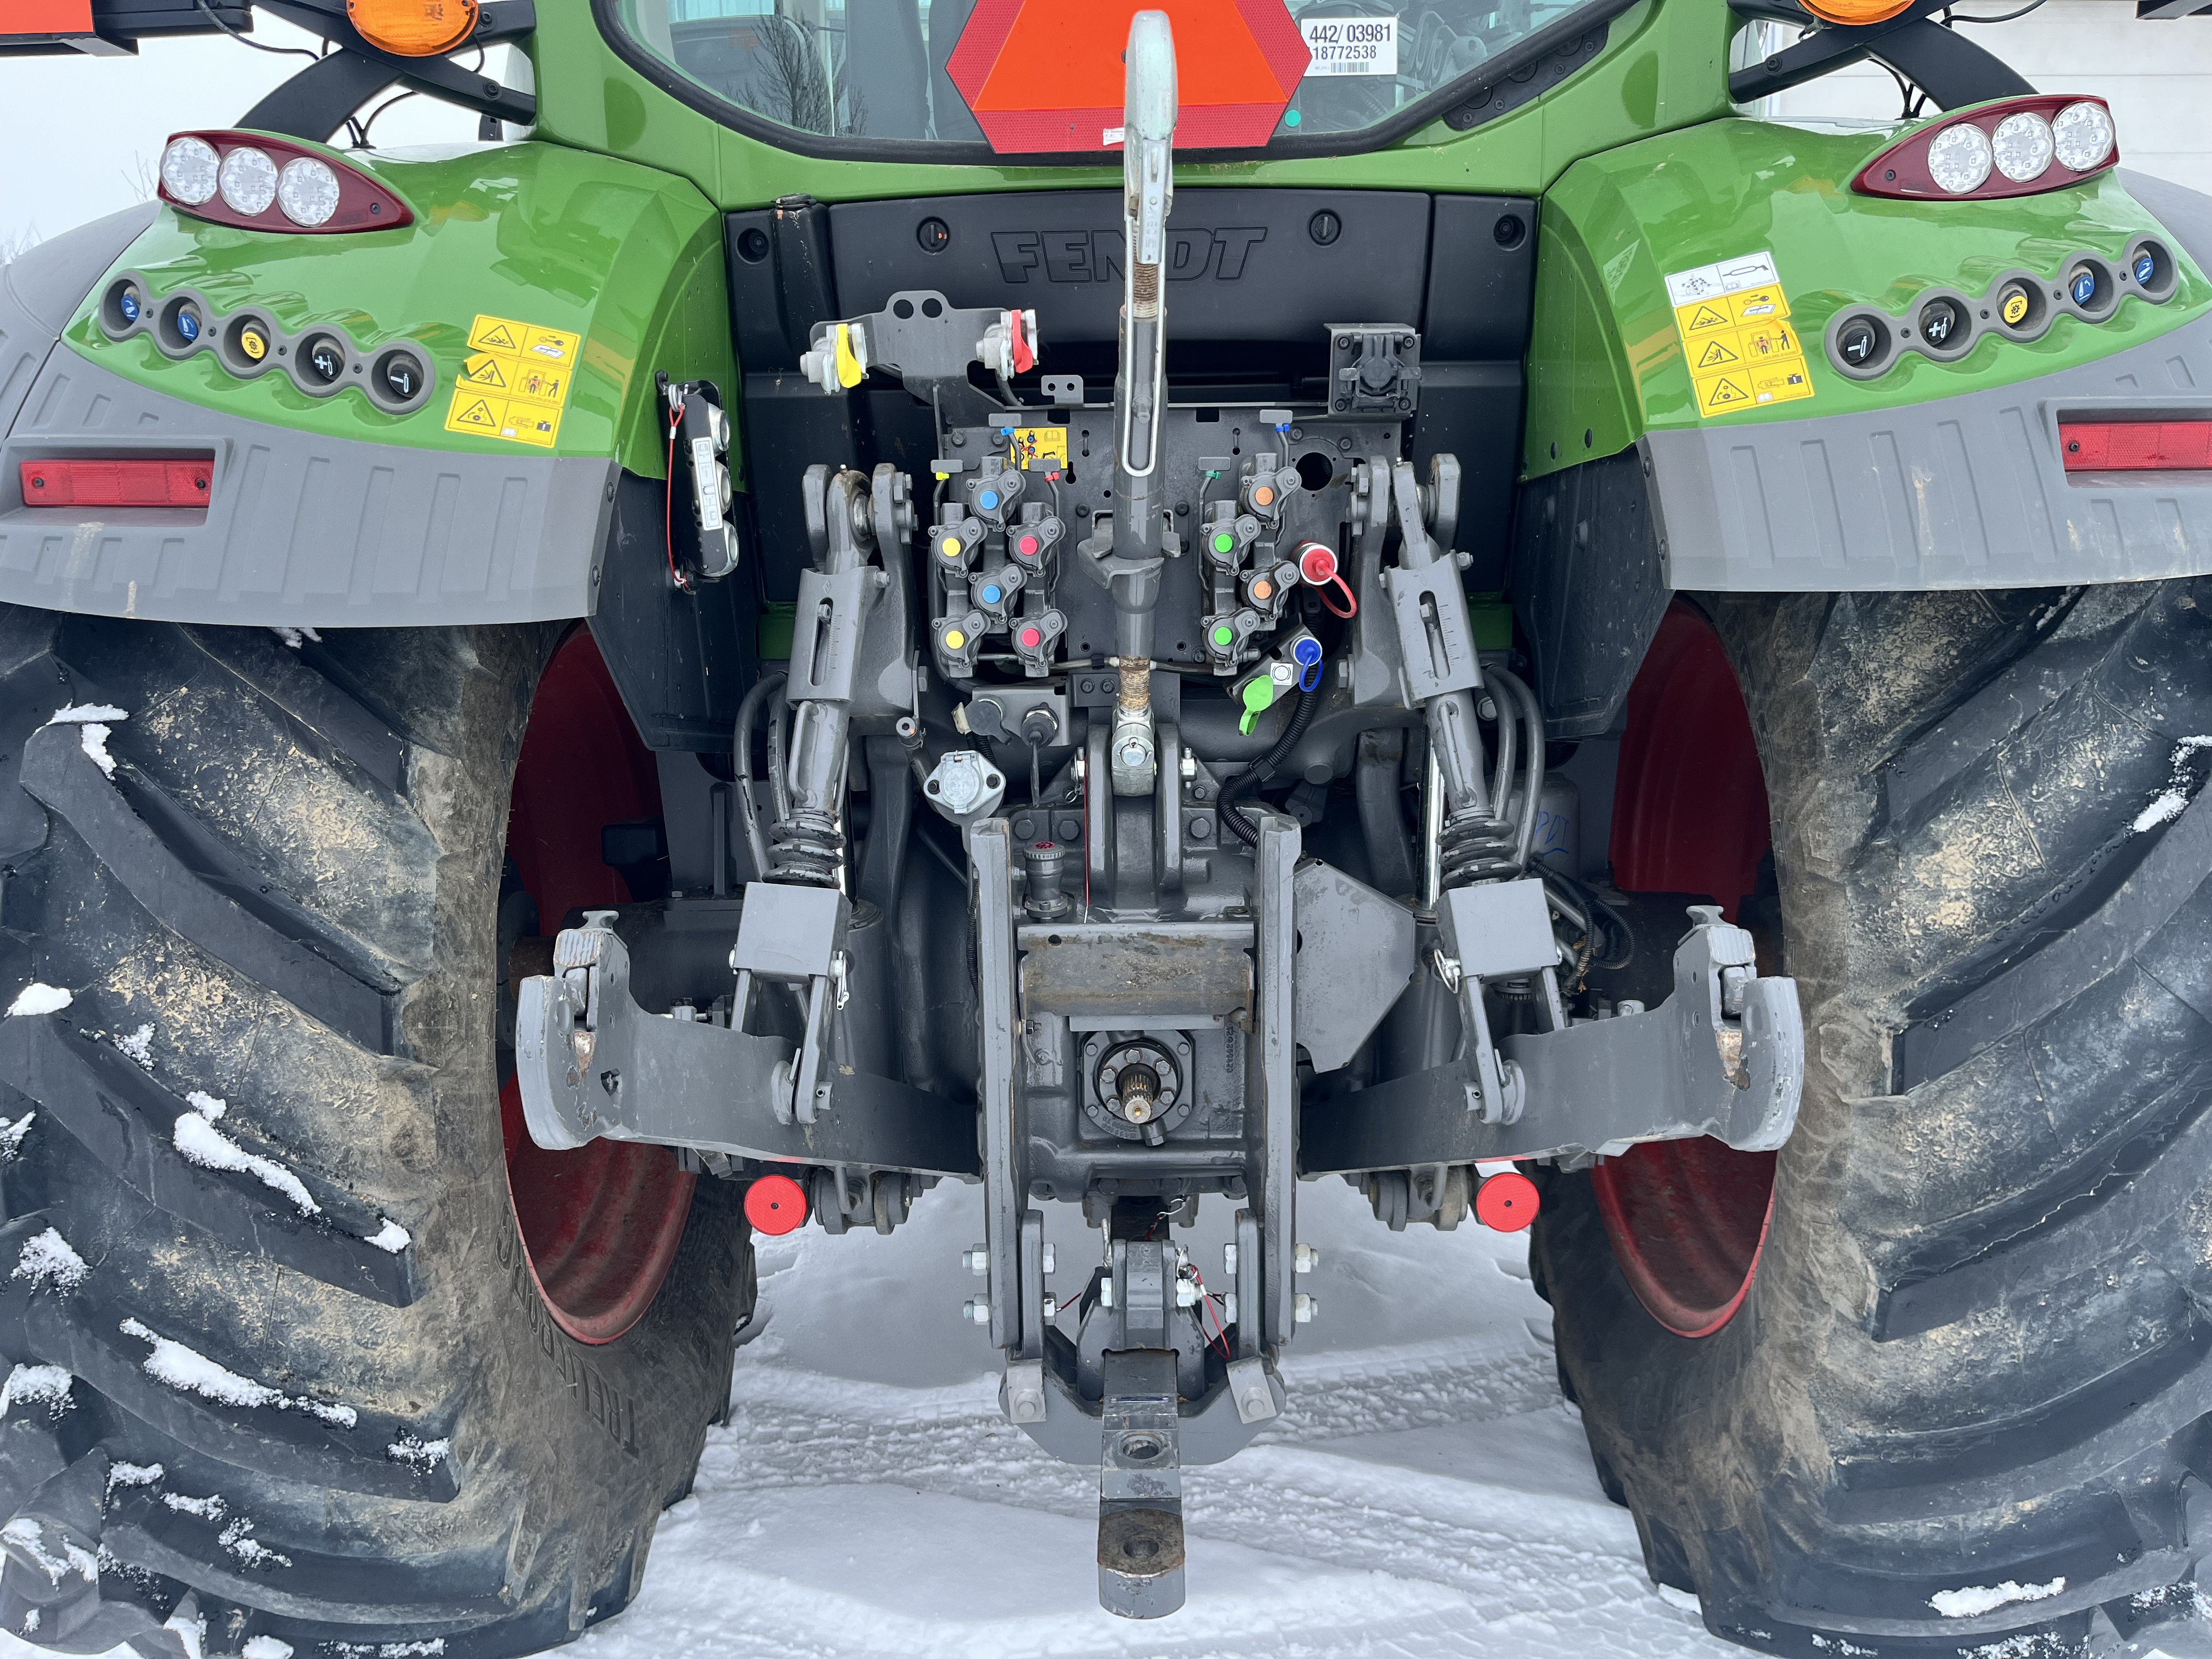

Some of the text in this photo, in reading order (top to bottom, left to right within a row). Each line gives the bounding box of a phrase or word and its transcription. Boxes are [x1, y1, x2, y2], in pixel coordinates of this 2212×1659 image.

[1309, 24, 1390, 44] 442/ 03981
[1307, 45, 1376, 60] 18772538
[990, 227, 1268, 283] FENDT
